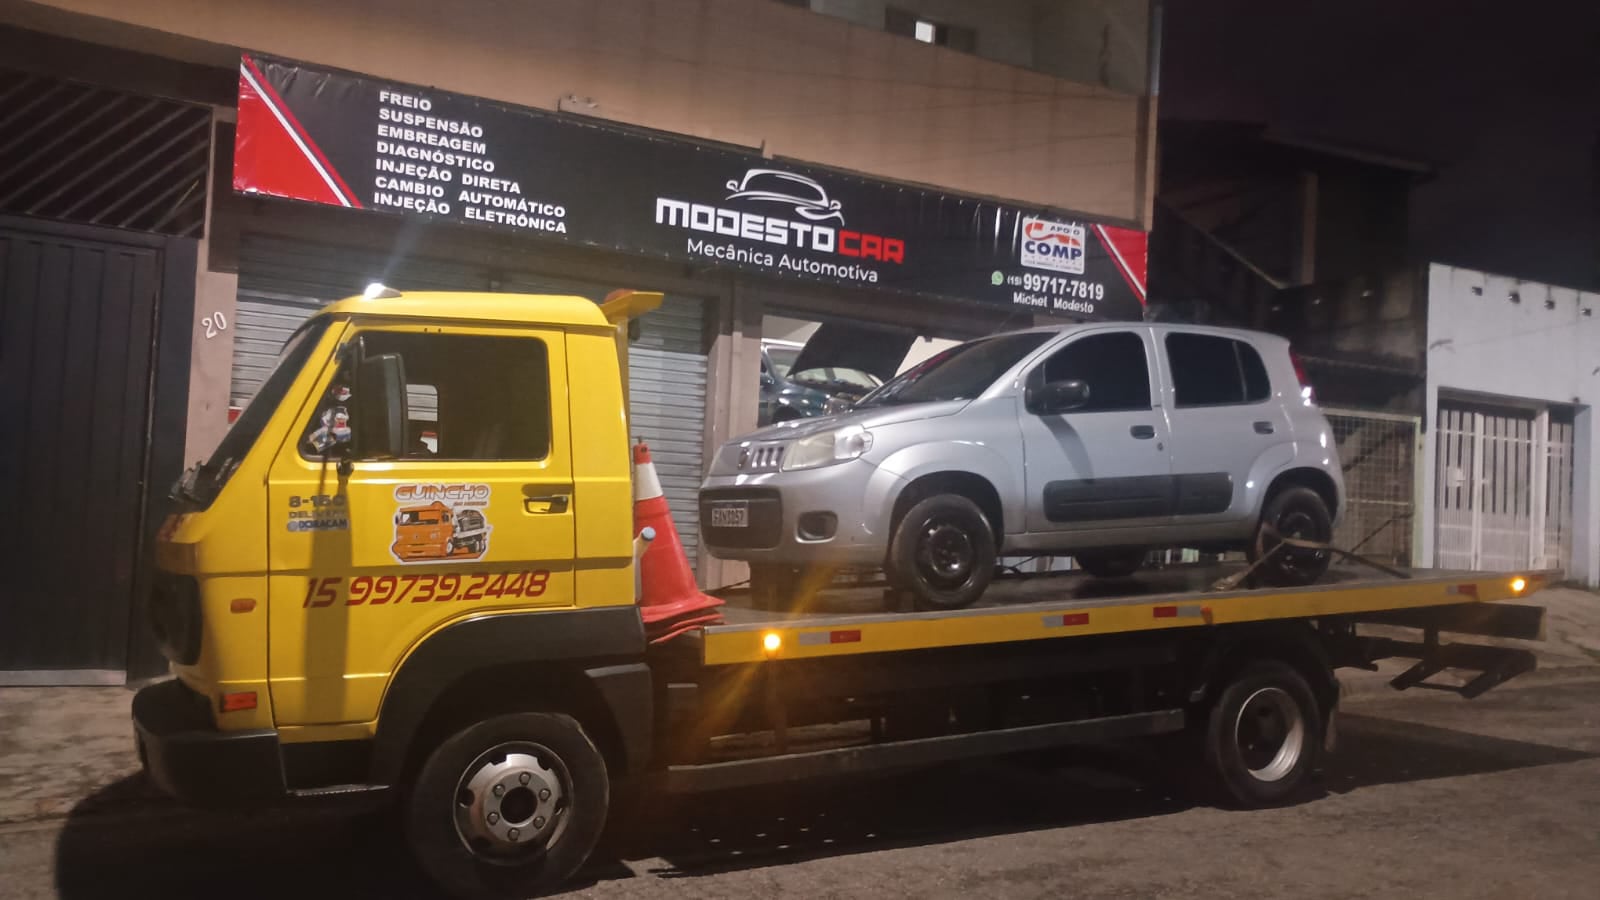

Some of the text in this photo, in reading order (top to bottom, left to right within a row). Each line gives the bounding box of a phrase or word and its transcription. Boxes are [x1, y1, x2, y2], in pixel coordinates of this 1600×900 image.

[379, 91, 432, 112] FREIO
[379, 108, 484, 138] SUSPENSÃO
[377, 124, 487, 155] EMBREAGEM
[376, 141, 496, 173] DIAGNÓSTICO
[375, 158, 521, 195] INJEÇÃO DIRETA
[375, 176, 567, 218] CAMBIO AUTOMÁTICO
[374, 192, 568, 234] INJEÇÃO ELETRÔNICA
[1050, 225, 1080, 236] APOO
[687, 238, 879, 283] Mecânica Automotiva
[1025, 240, 1082, 260] COMP
[1023, 273, 1105, 300] 99717-7819
[1013, 291, 1095, 313] Michel Modesto
[201, 311, 228, 339] 20
[396, 484, 489, 500] GUINCHO
[302, 570, 551, 608] 15 99739.2448
